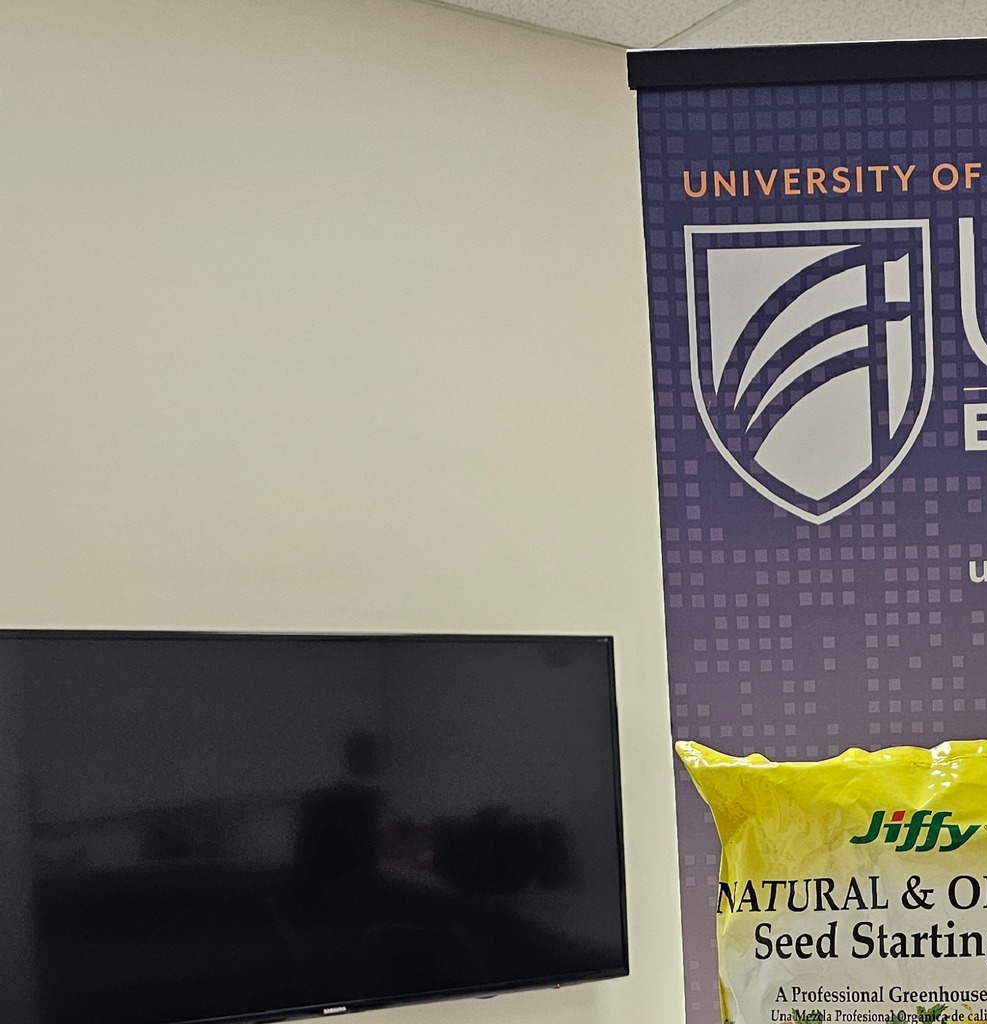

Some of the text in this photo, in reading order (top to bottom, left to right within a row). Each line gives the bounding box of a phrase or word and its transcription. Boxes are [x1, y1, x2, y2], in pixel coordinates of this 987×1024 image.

[683, 164, 916, 198] UNIVERSITY
[932, 162, 982, 191] OF
[850, 809, 981, 853] Jiffy
[716, 875, 890, 914] NATURAL
[901, 874, 934, 910] &
[754, 921, 837, 959] Seed
[775, 986, 788, 1002] A
[791, 985, 884, 1003] Professional
[889, 985, 987, 1003] Greenhouse
[771, 1009, 792, 1022] Una
[795, 1008, 832, 1023] Mezcla
[834, 1008, 894, 1023] Profesional
[951, 1008, 965, 1022] de
